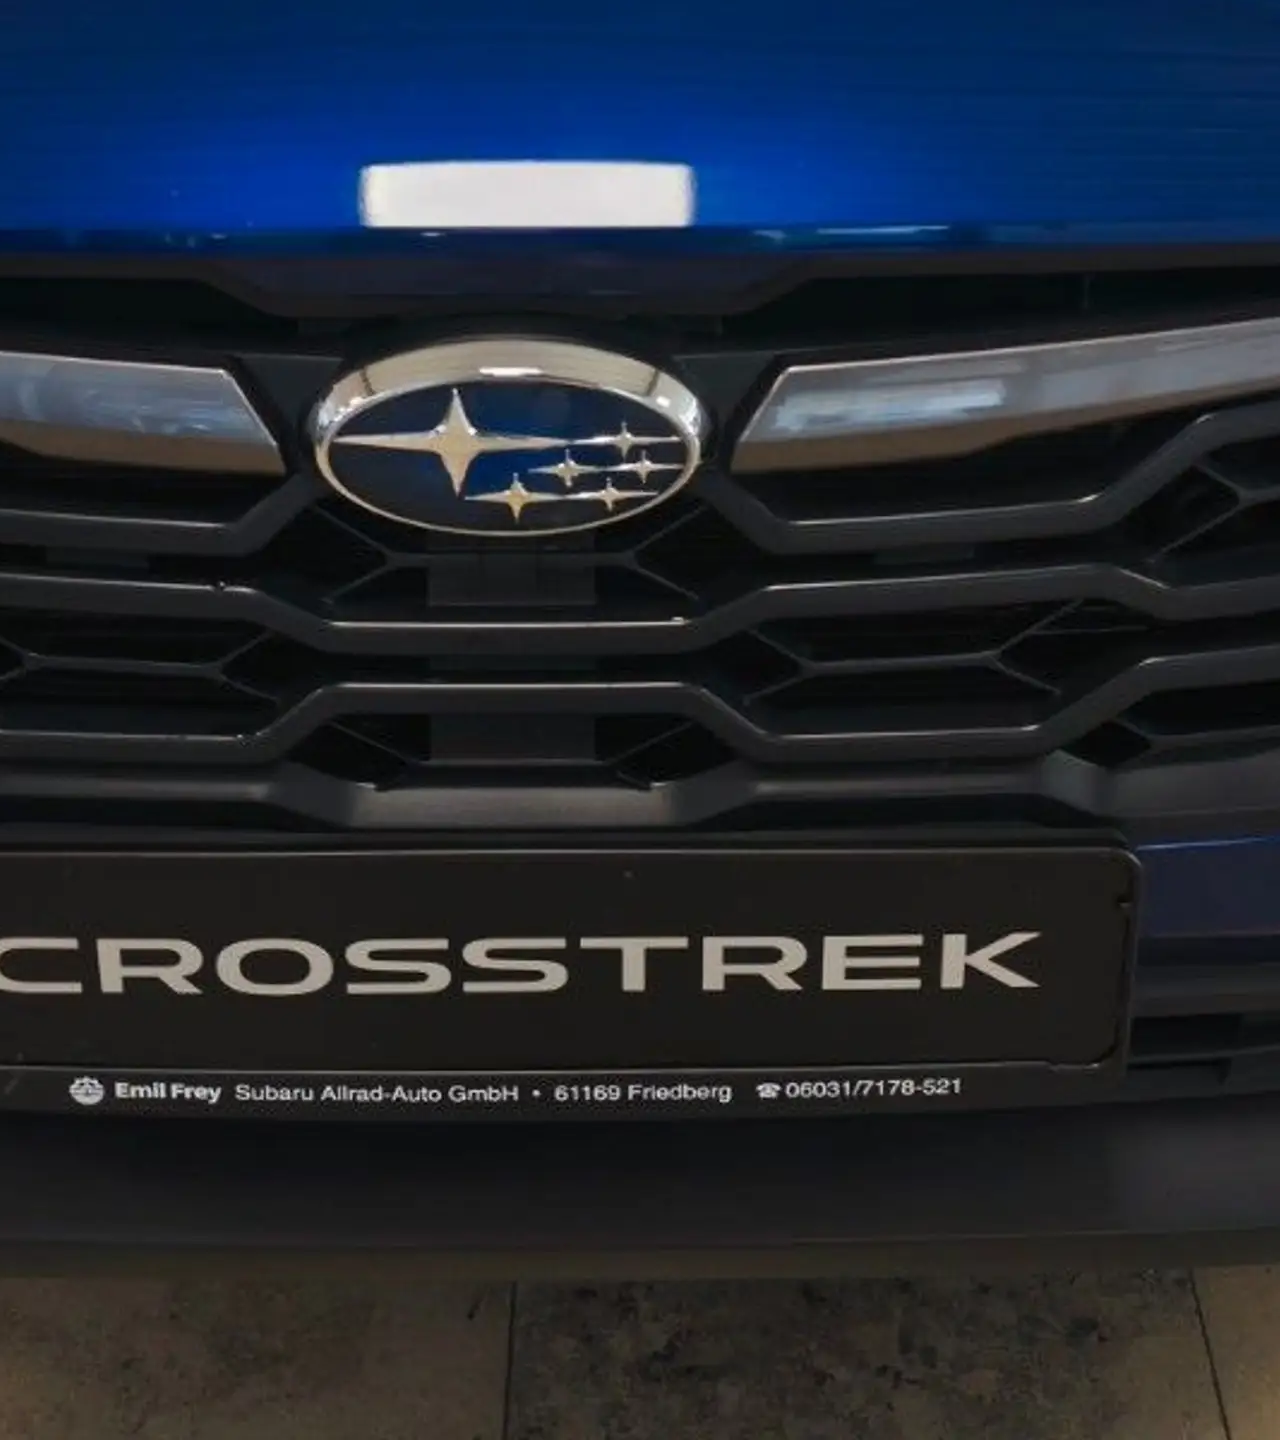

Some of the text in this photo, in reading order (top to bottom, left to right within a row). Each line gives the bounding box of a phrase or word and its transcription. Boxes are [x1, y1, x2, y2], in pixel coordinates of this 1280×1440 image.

[114, 1077, 961, 1105] Emil Frey Subaru Allrad-Auto GmbH 61169 Friedberg 06031/7178-521
